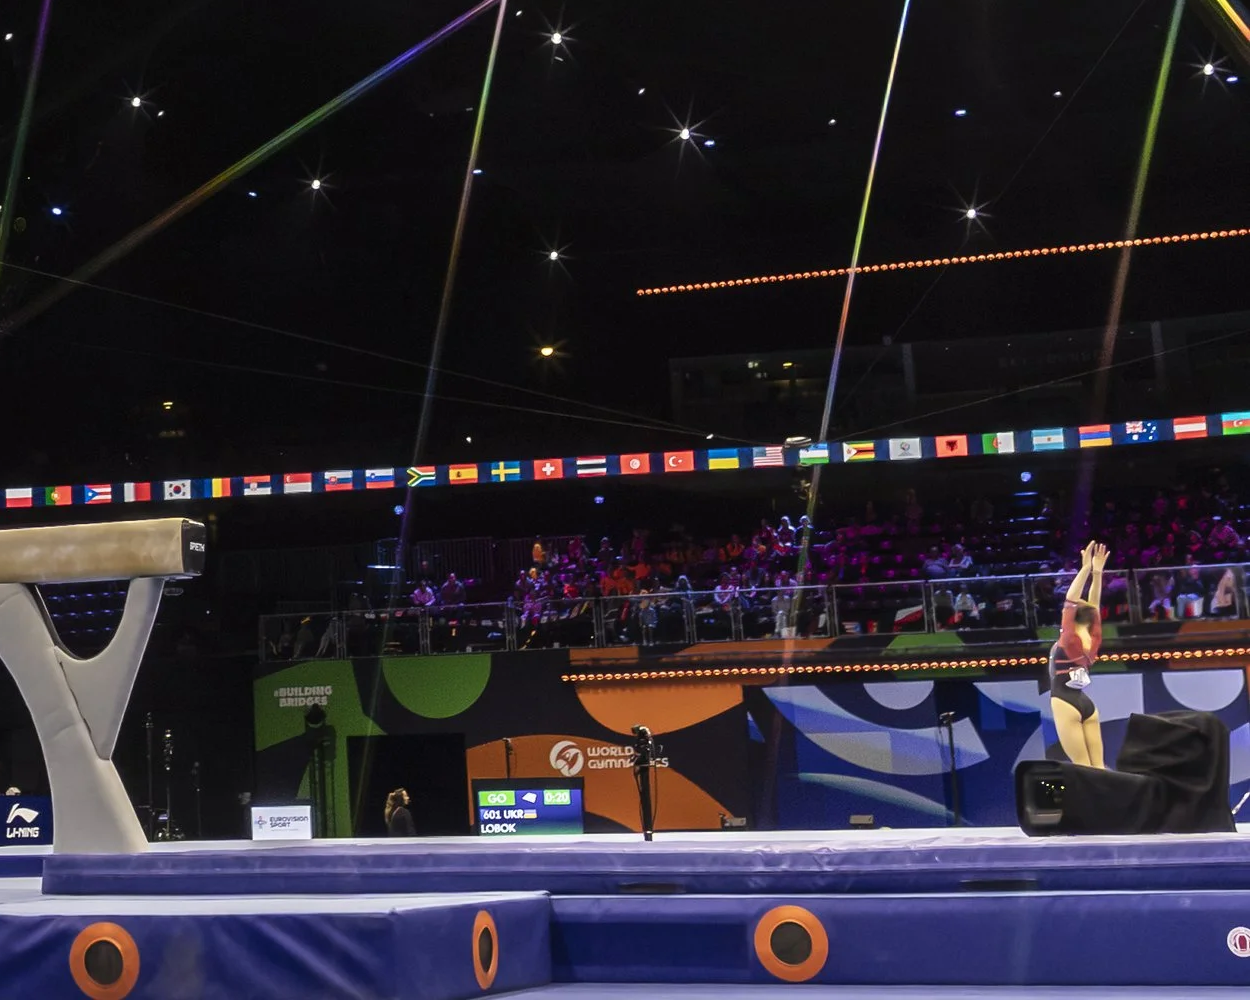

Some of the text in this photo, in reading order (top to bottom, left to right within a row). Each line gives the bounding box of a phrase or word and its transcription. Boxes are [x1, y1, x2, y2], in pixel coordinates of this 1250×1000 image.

[587, 746, 634, 756] WORLD
[488, 794, 507, 803] GO
[483, 809, 524, 819] 601 UKR
[6, 827, 39, 838] LI-NING
[481, 823, 516, 833] LOBOK
